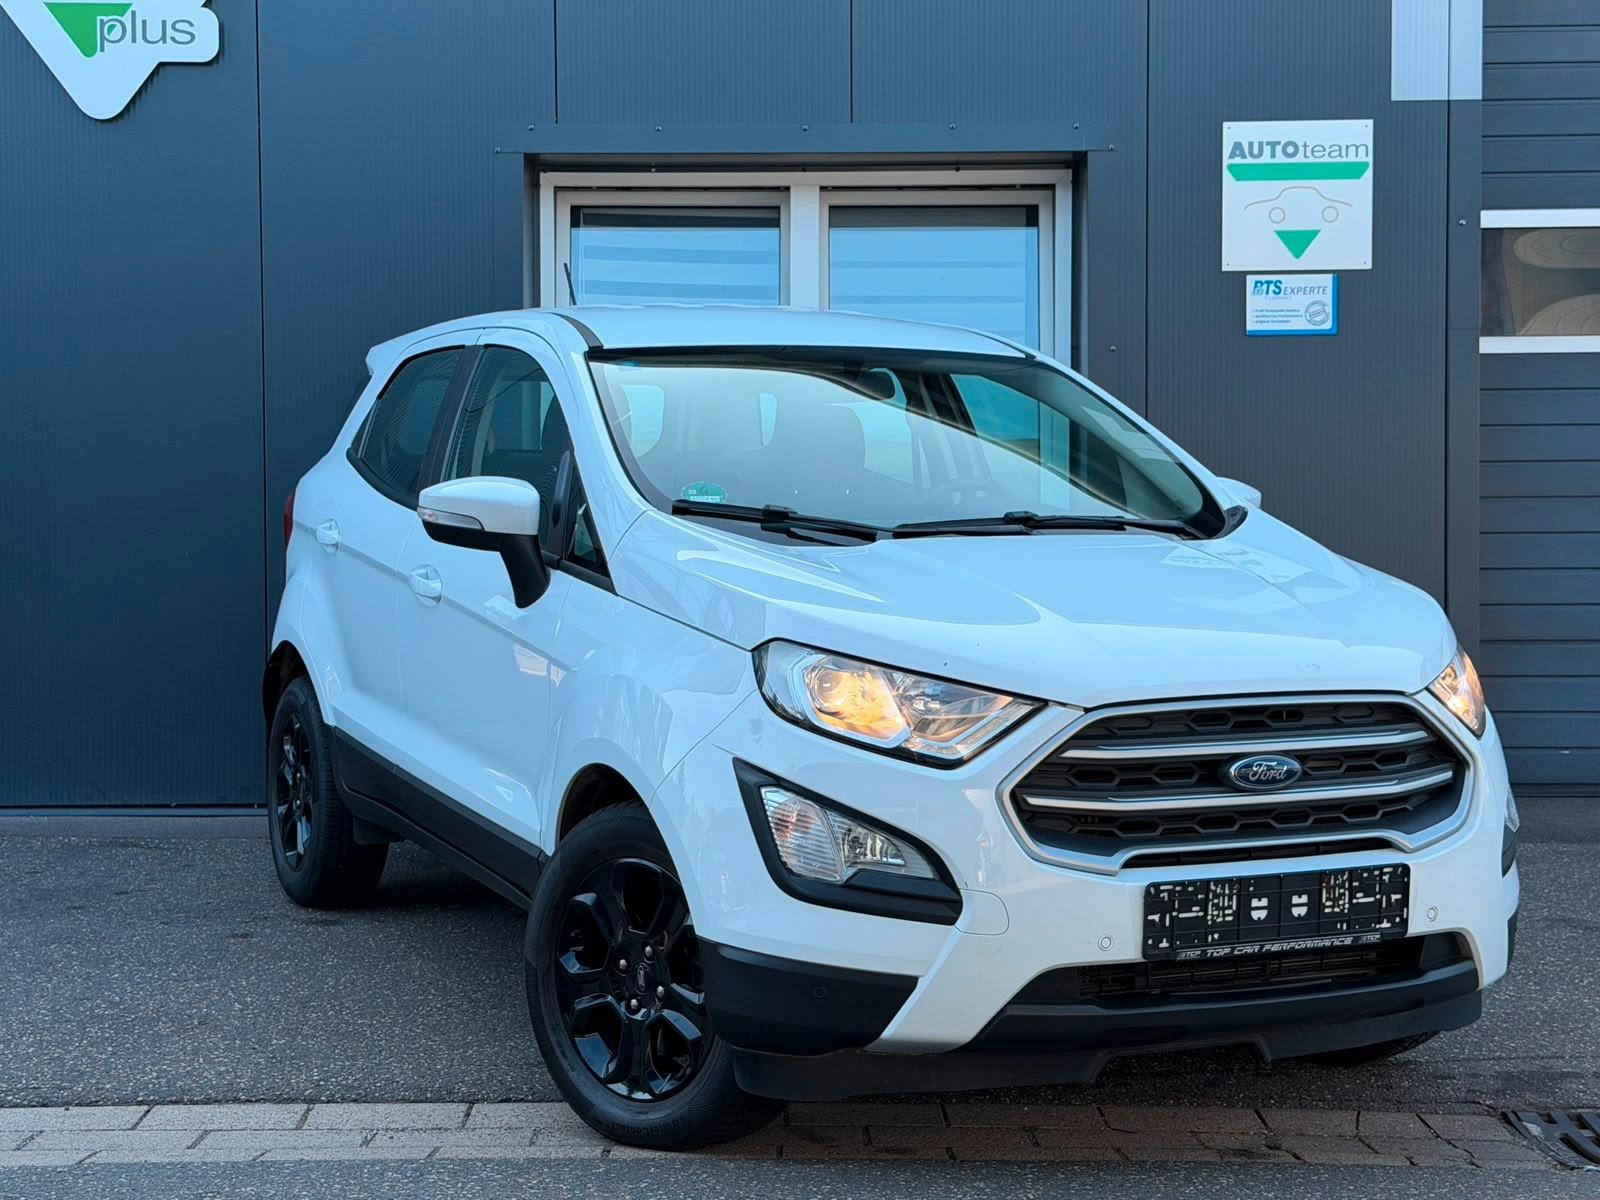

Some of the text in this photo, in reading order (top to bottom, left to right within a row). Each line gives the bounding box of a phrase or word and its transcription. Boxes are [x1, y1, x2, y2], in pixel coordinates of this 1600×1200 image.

[99, 9, 196, 53] plus
[1227, 140, 1370, 160] AUTOteam
[1283, 285, 1329, 296] EXPERTE
[1248, 761, 1288, 782] Ford
[1206, 947, 1232, 958] TOP
[1233, 944, 1261, 955] CAR
[1261, 936, 1354, 953] PERFORMANCE
